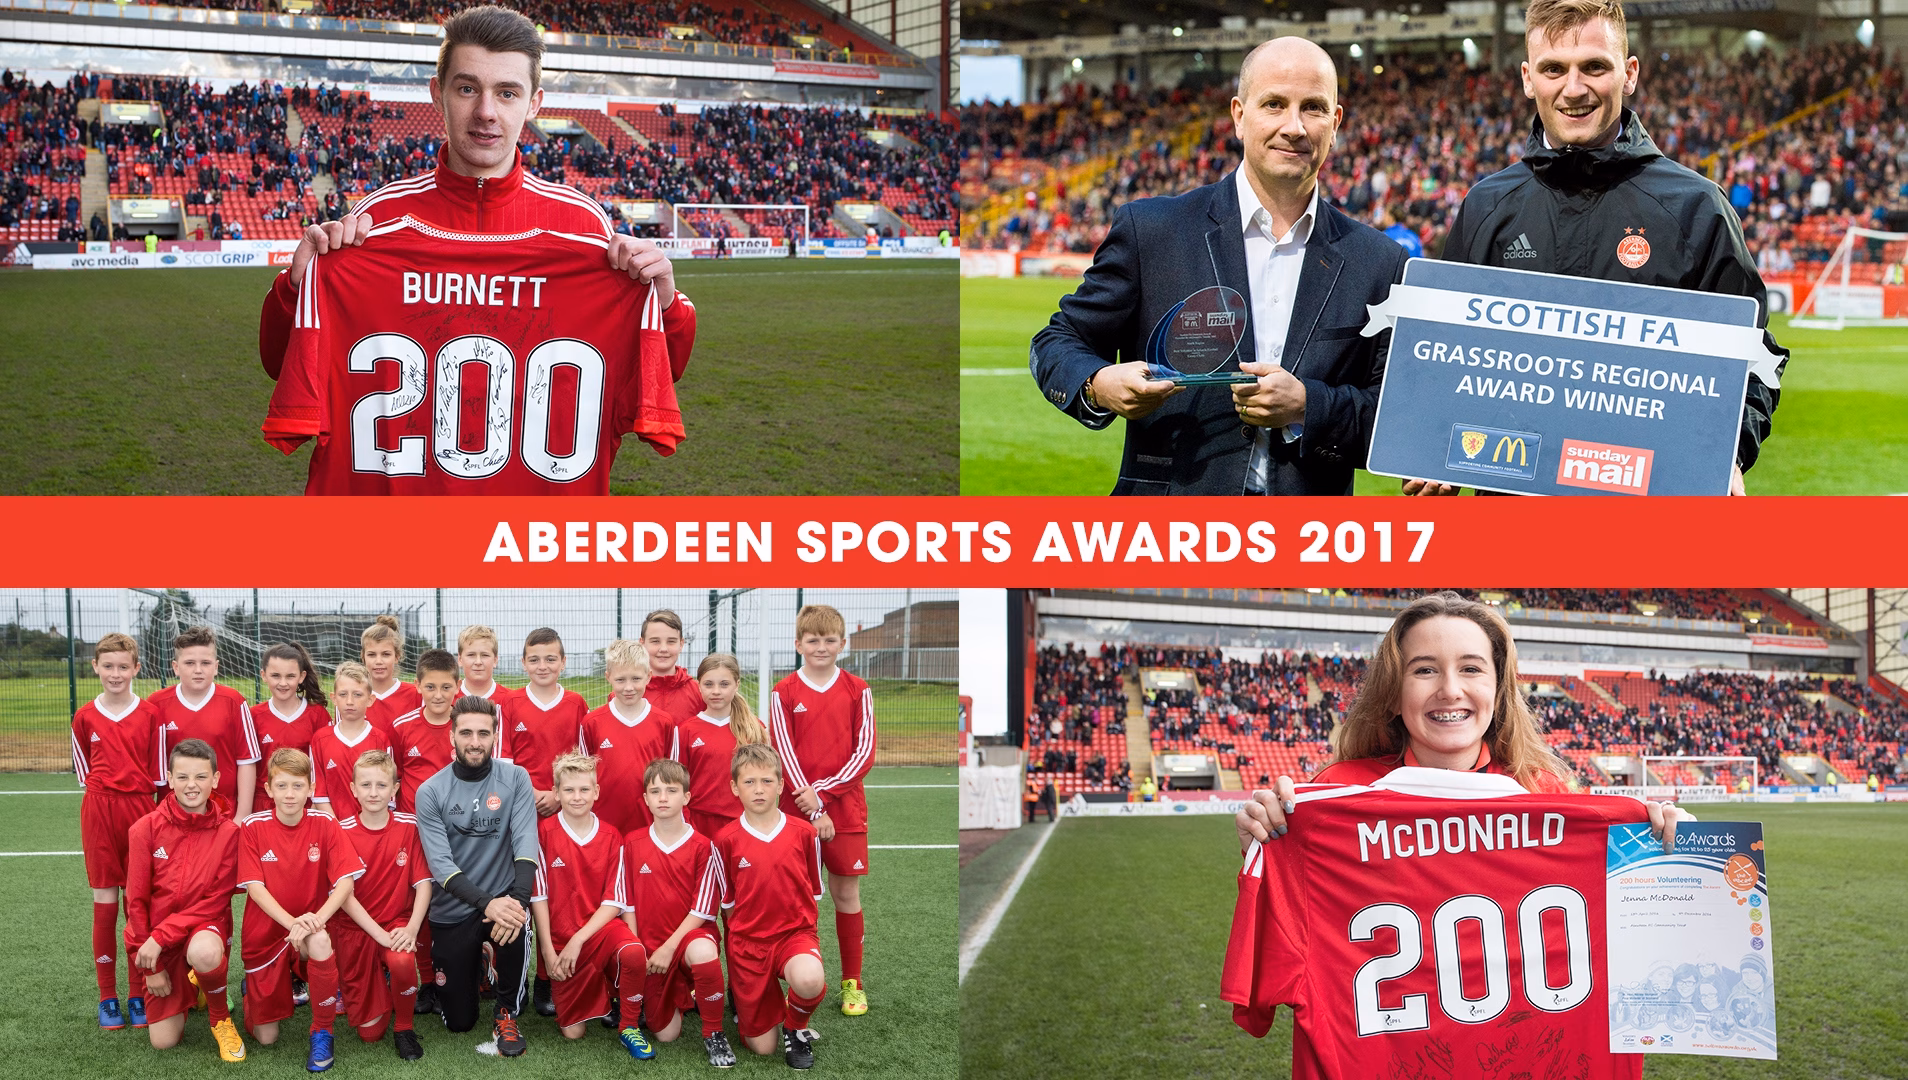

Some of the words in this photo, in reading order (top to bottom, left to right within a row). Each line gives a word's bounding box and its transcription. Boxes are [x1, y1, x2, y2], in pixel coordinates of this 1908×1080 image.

[71, 258, 95, 267] avc
[97, 255, 139, 266] media
[185, 253, 255, 264] SCOTGRIP
[1503, 249, 1537, 260] adidas
[403, 271, 547, 308] BURNETT
[1466, 298, 1626, 340] SCOTTISH
[1639, 309, 1680, 347] FA
[1413, 340, 1585, 380] GRASSROOTS
[1591, 362, 1721, 398] REGIONAL
[348, 331, 606, 484] 200
[1455, 375, 1555, 405] AWARD
[1564, 387, 1666, 420] WINNER
[1566, 446, 1632, 466] sunday
[1562, 456, 1647, 488] mail
[473, 799, 480, 812] 3
[1357, 812, 1565, 862] McDONALD
[1686, 831, 1736, 847] Awards
[1619, 877, 1633, 885] 200
[1657, 876, 1702, 885] Volunteering
[1621, 895, 1648, 903] Jenna
[1649, 894, 1695, 902] McDonald
[1347, 883, 1594, 1038] 200
